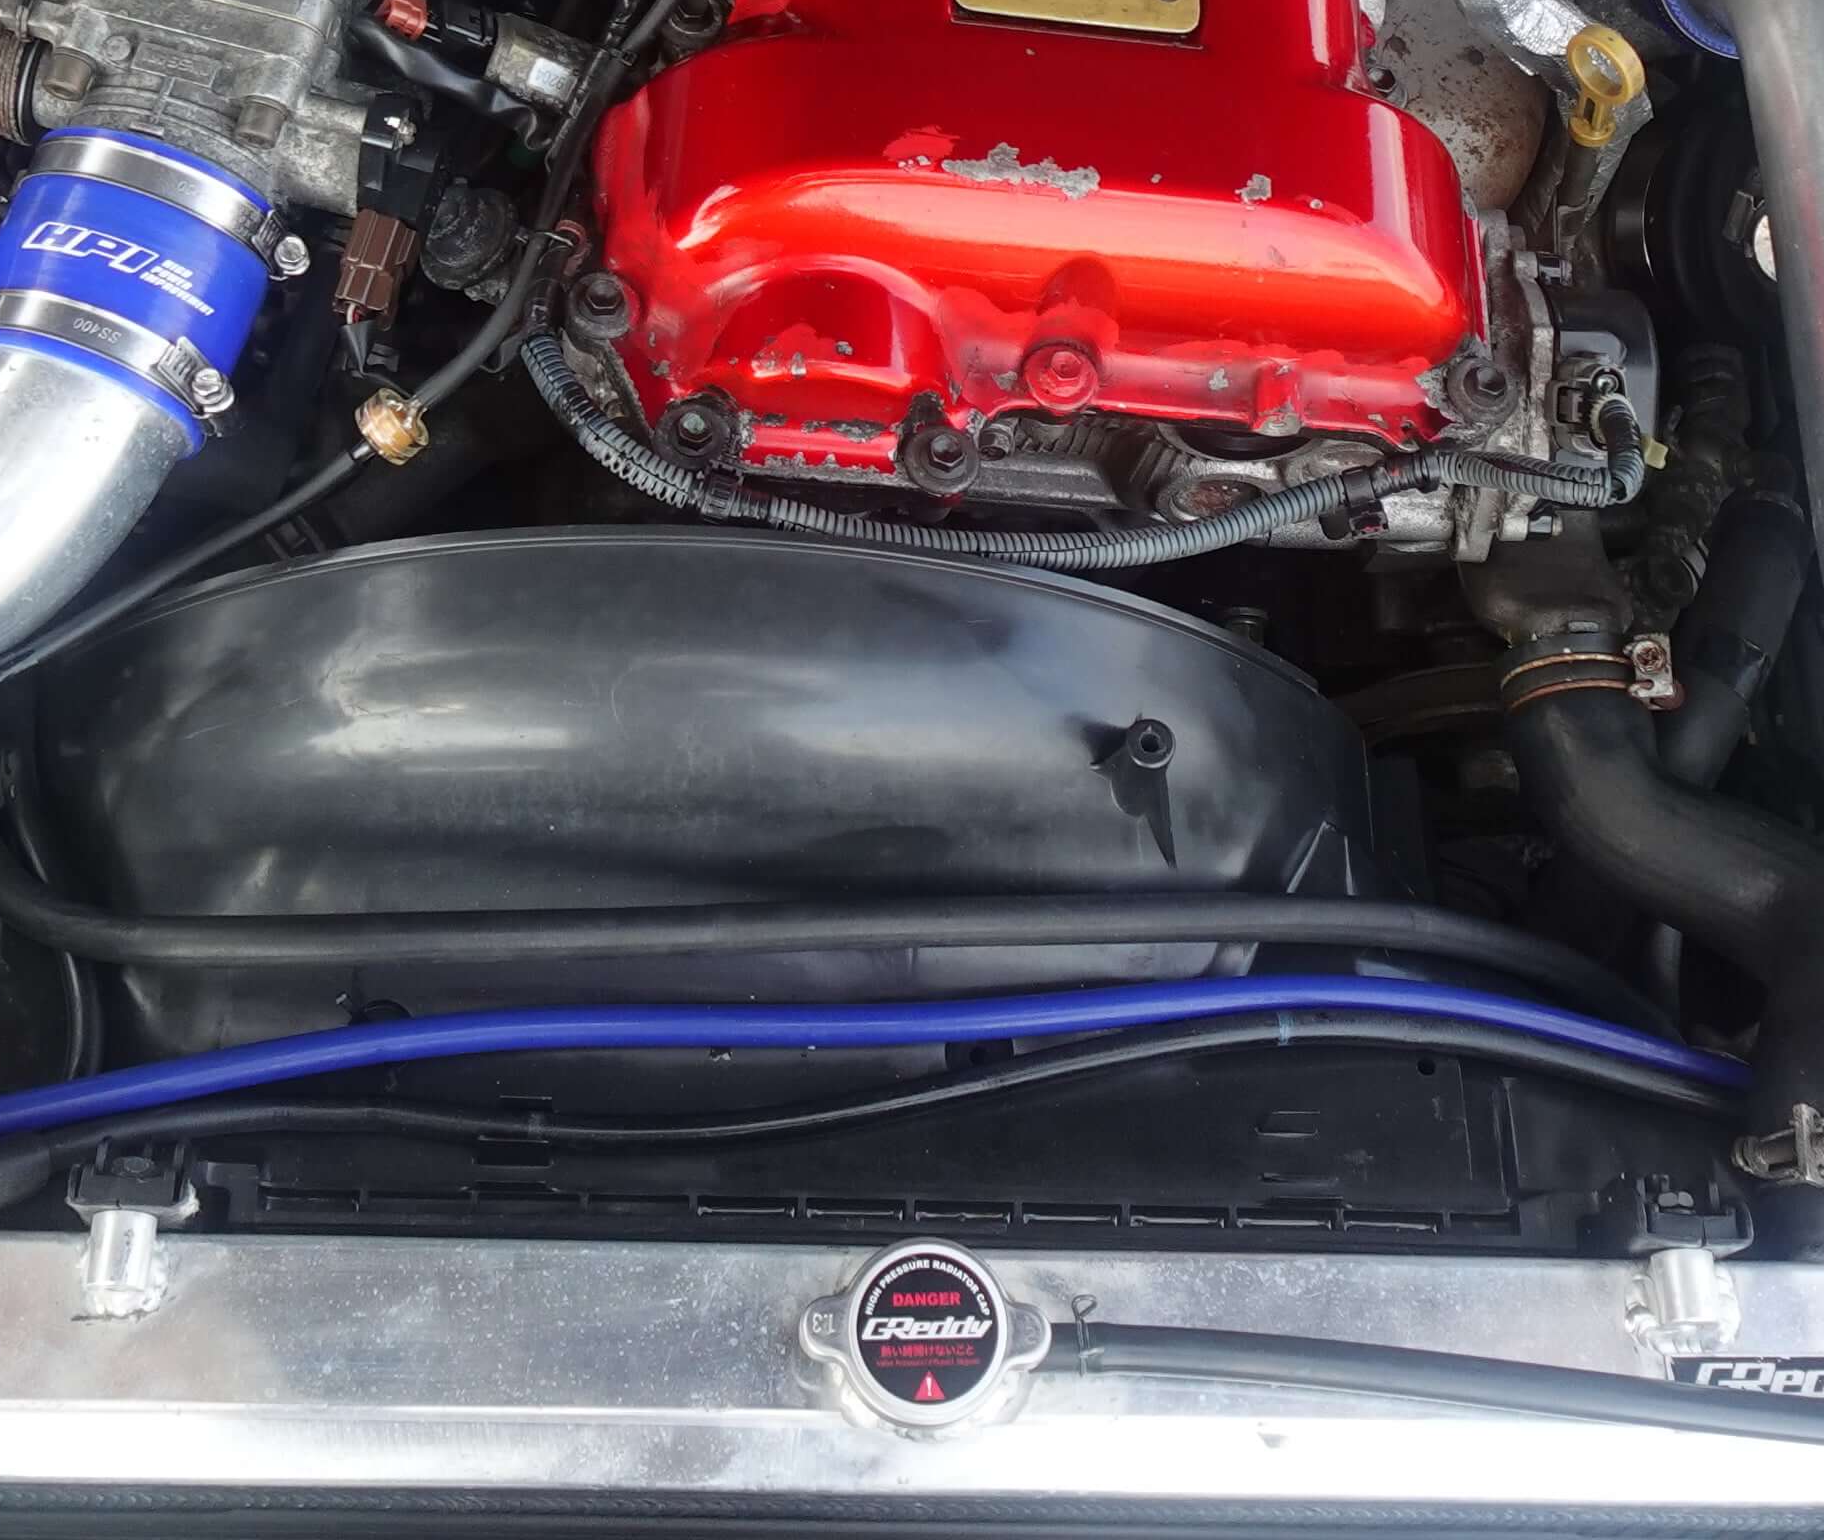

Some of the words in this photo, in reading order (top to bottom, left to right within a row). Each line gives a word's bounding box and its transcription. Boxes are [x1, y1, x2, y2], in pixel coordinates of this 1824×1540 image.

[21, 222, 160, 273] HPI
[72, 317, 122, 344] SS400
[865, 1286, 882, 1316] HIGH
[879, 1259, 931, 1290] PRESSURE
[931, 1260, 979, 1296] RADIATOR
[975, 1291, 991, 1317] CAP
[892, 1291, 961, 1307] DANGER
[861, 1315, 993, 1341] GReddy
